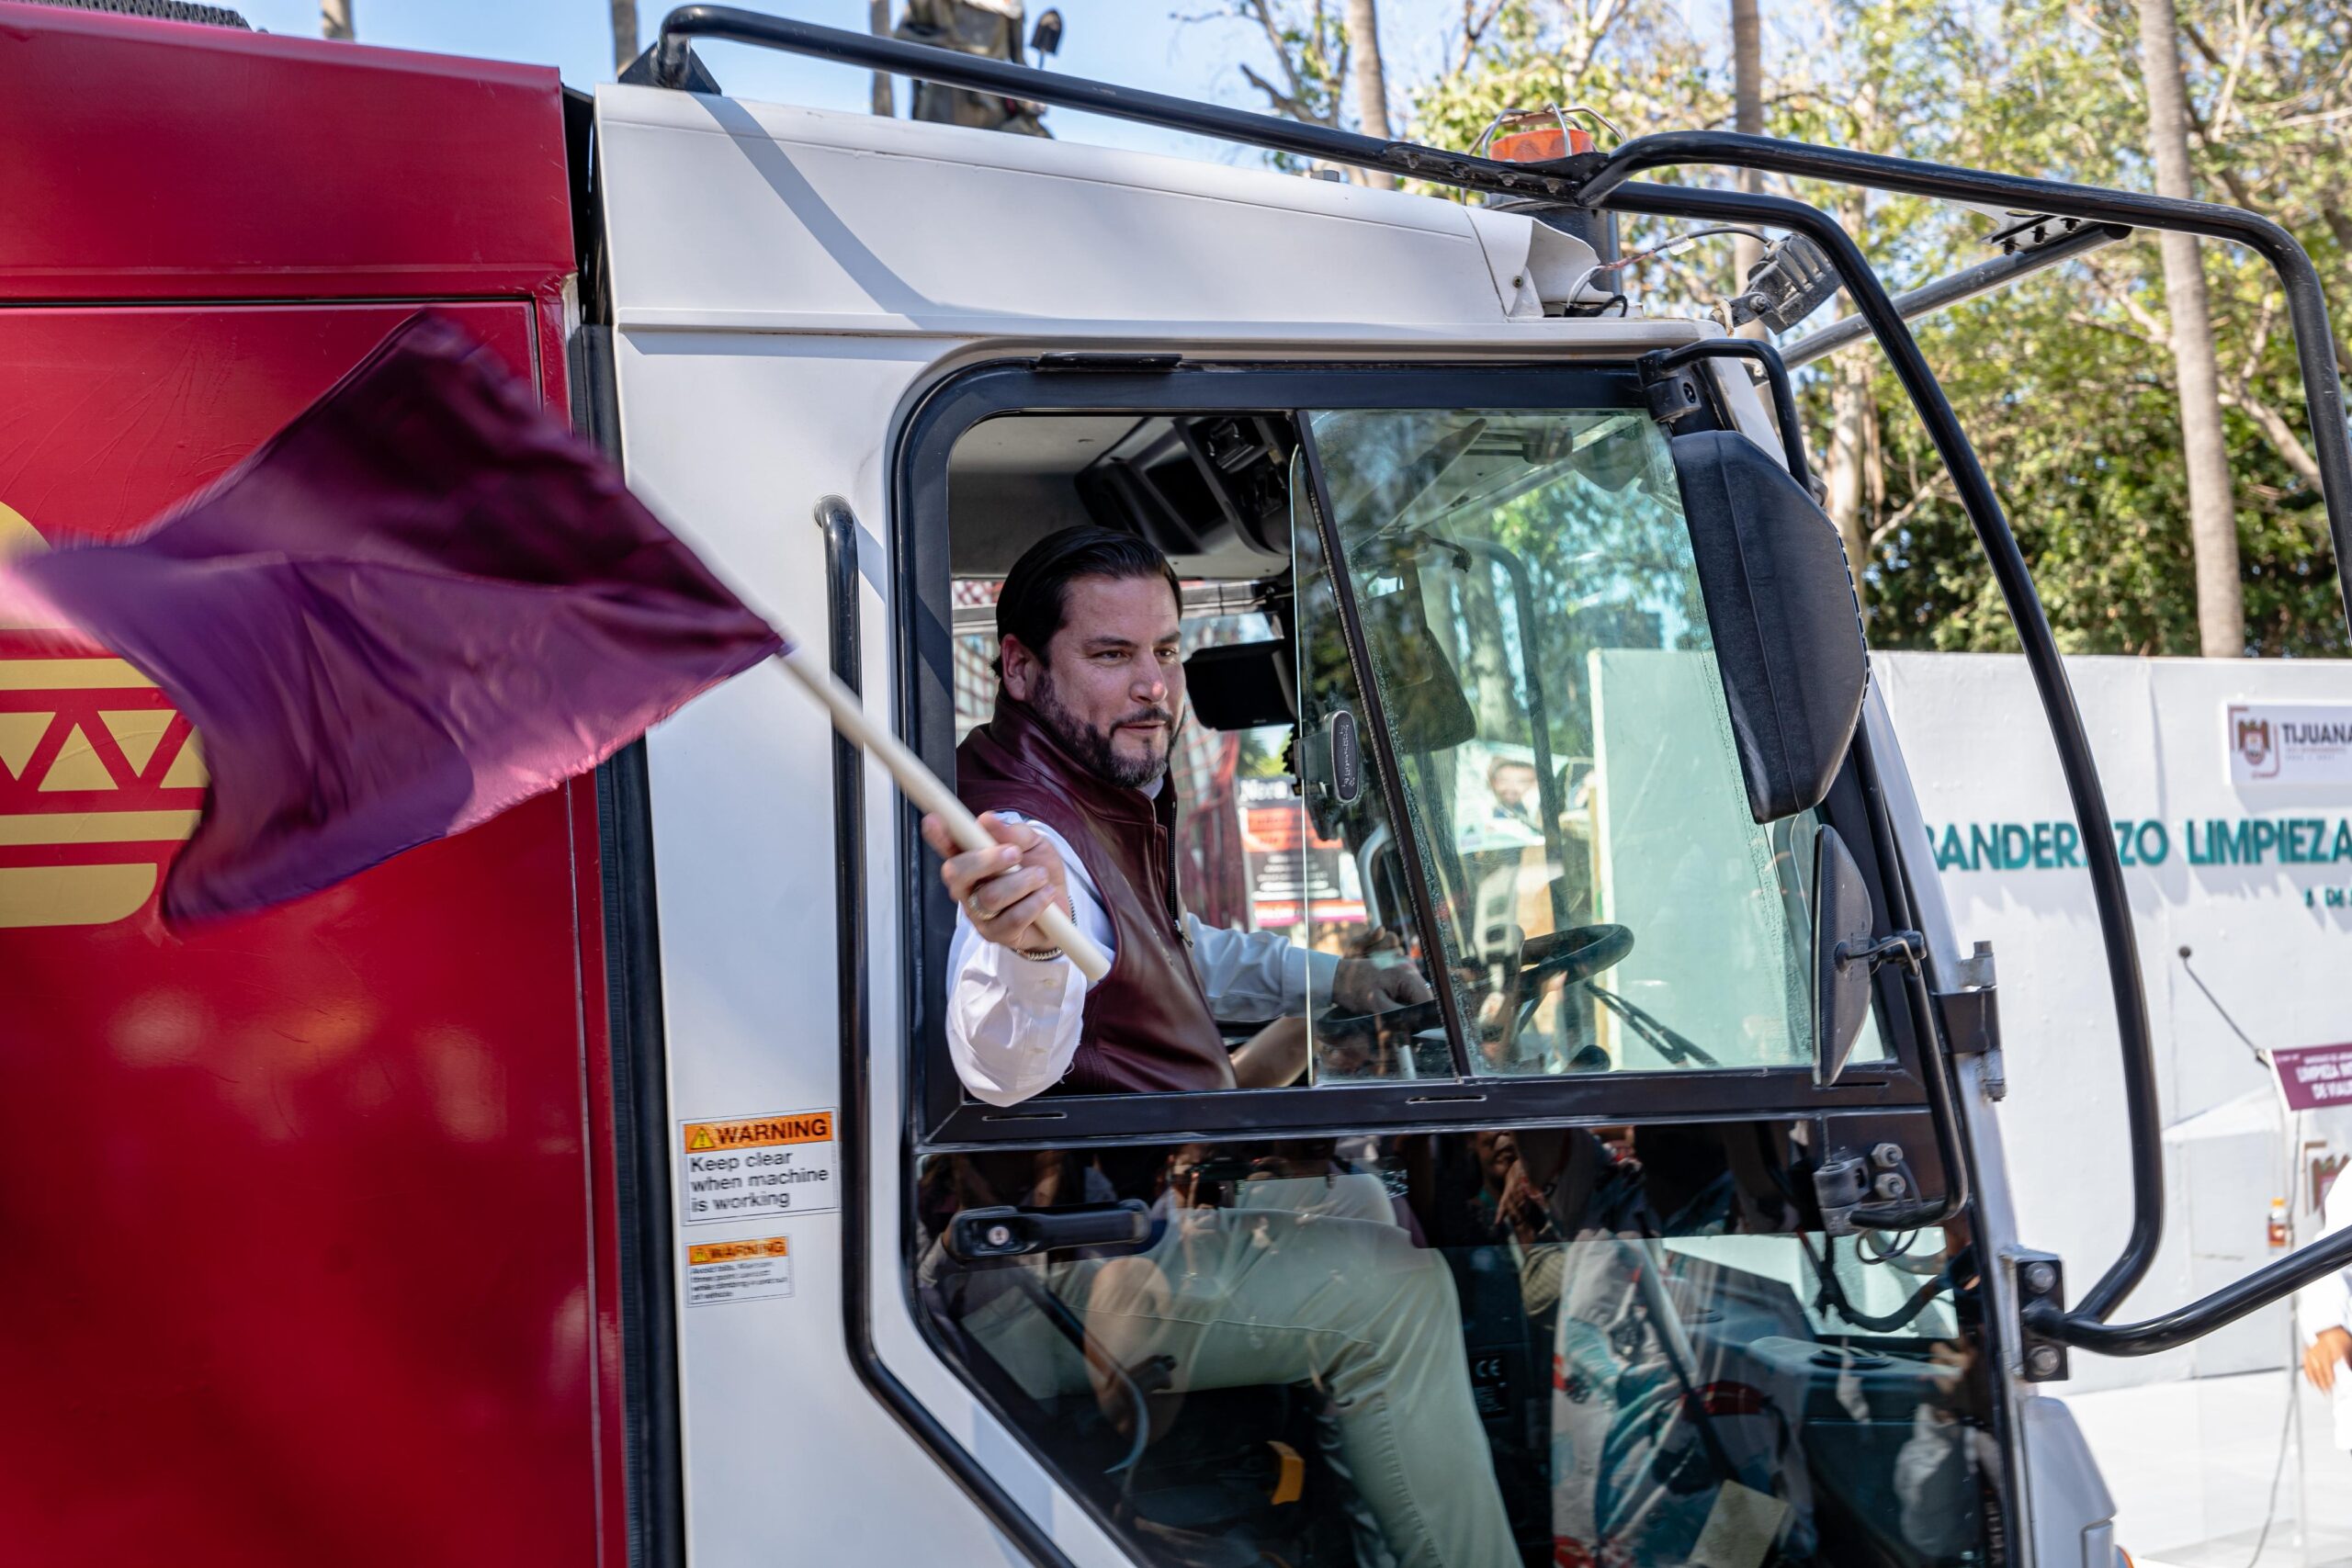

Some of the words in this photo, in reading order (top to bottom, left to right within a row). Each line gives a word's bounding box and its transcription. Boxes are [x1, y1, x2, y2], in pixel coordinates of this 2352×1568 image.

[1925, 818, 2170, 872] ANDERZO
[2184, 818, 2352, 866] LIMPIEZA
[716, 1118, 827, 1145] WARNING
[690, 1156, 741, 1173] Keep
[745, 1151, 794, 1168] clear
[690, 1175, 742, 1192] when
[748, 1168, 829, 1187] machine
[691, 1197, 708, 1213] is
[712, 1191, 790, 1209] working
